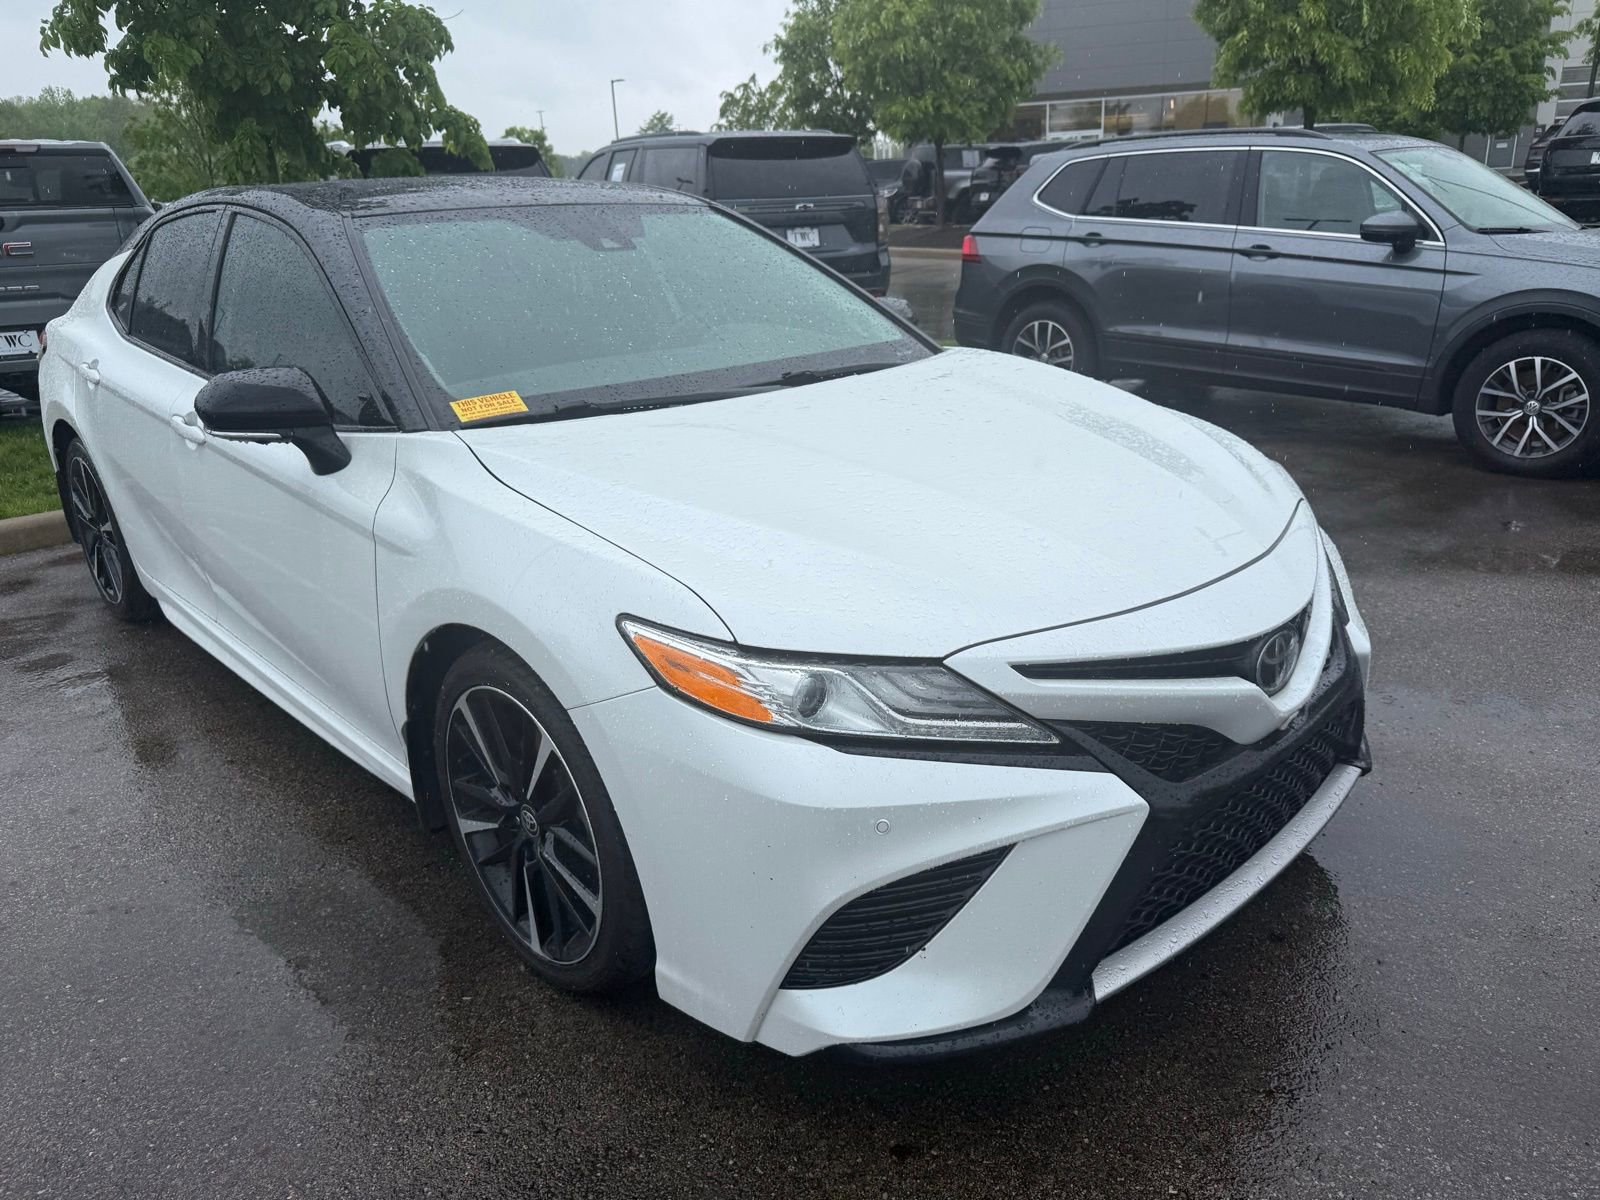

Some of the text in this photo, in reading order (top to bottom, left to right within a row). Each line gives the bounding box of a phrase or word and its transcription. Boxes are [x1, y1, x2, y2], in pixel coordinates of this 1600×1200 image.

[455, 393, 516, 409] THIS VEHICLE
[460, 404, 478, 413] NOT
[480, 402, 495, 410] FOR
[496, 398, 518, 407] SALE
